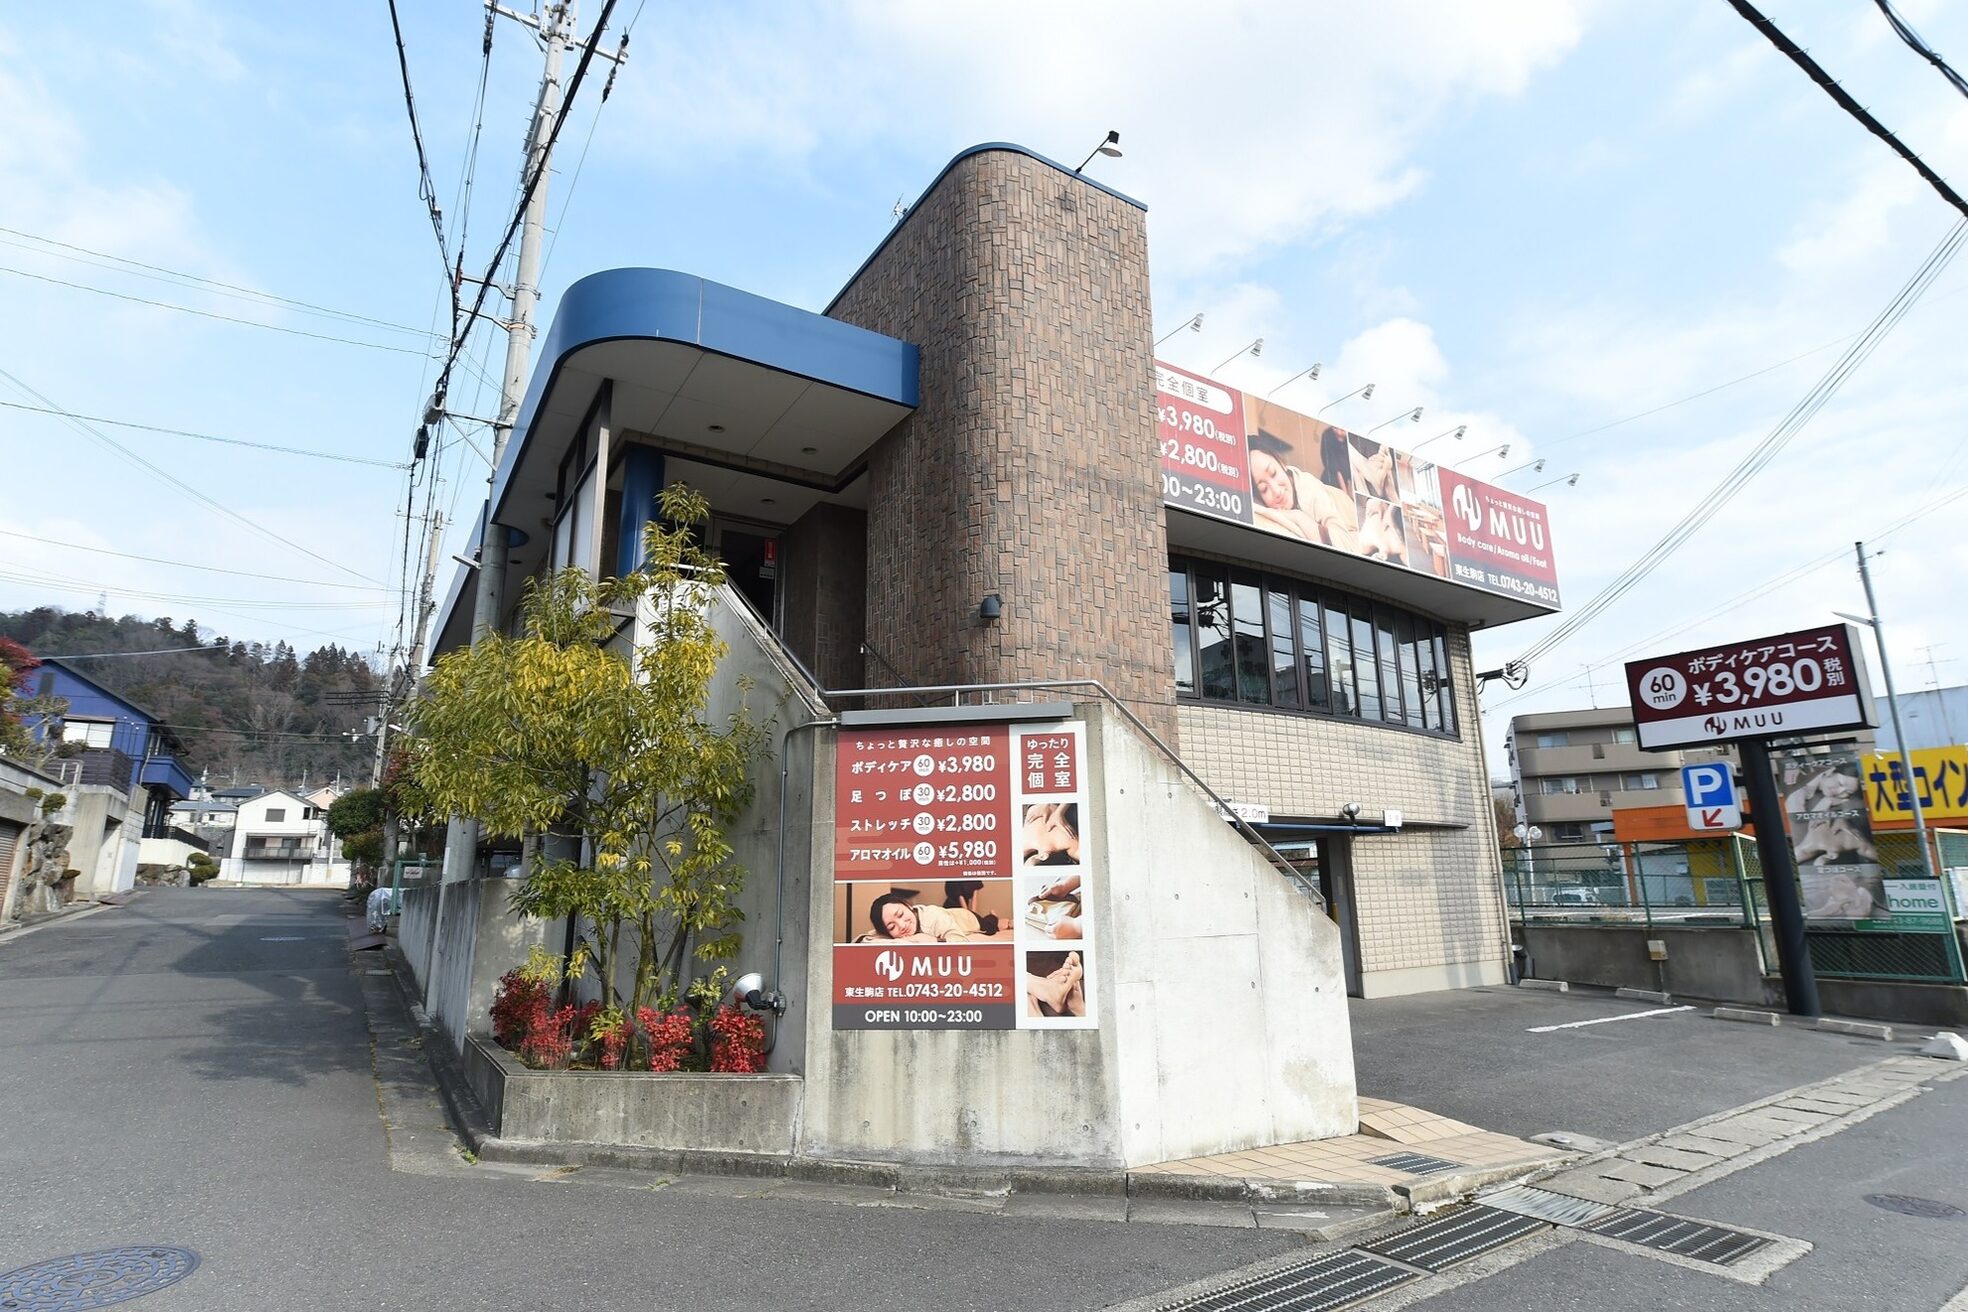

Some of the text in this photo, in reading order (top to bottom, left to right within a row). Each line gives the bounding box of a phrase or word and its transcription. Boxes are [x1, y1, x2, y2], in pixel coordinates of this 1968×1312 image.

[1489, 507, 1544, 551] MUU
[1457, 532, 1476, 549] Body
[1454, 563, 1485, 583] 東生駒店
[1687, 635, 1838, 675] ボディケアコース
[1823, 656, 1845, 687] 税別
[1650, 673, 1675, 694] 60
[1691, 657, 1822, 707] ¥3,980
[1652, 692, 1677, 704] min
[1733, 711, 1783, 730] MUU
[1027, 737, 1069, 750] ゆったり
[851, 760, 912, 774] ボディケア
[917, 758, 931, 768] 60
[938, 754, 995, 773] ¥3,980
[917, 786, 931, 797] 30
[937, 784, 996, 803] ¥2,800
[1688, 767, 1723, 805] P
[850, 818, 911, 832] ストレッチ
[917, 816, 931, 826] 30
[937, 813, 996, 832] ¥2,800
[850, 847, 912, 861] アロマオイル
[917, 845, 931, 856] 60
[938, 840, 997, 859] ¥5,980
[1887, 894, 1939, 908] home
[911, 955, 972, 977] MUU
[844, 986, 884, 998] 東生駒店
[864, 1010, 900, 1023] OPEN
